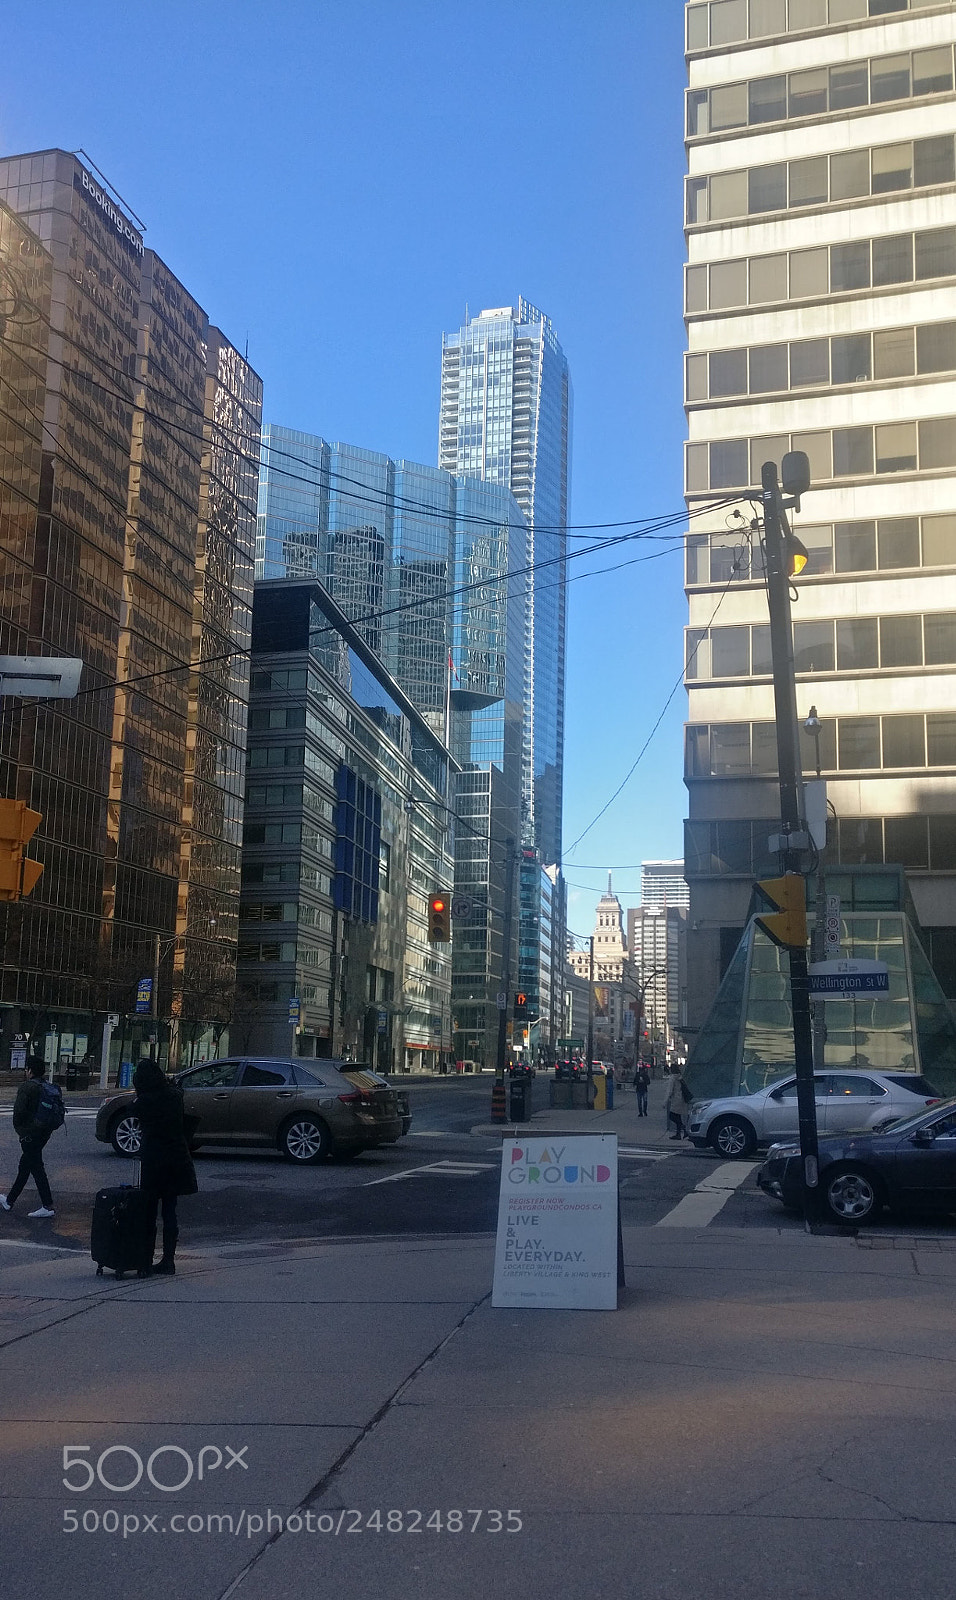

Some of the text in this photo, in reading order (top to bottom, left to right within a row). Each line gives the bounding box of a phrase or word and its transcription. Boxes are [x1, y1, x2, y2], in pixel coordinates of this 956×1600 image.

[82, 170, 145, 257] Booking.com
[811, 975, 886, 990] Wellington St W
[511, 1147, 566, 1165] PLAY
[508, 1165, 611, 1185] GROUND
[507, 1215, 540, 1226] LIVE
[506, 1227, 516, 1238] &
[505, 1239, 545, 1250] PLAY.
[504, 1251, 586, 1262] EVERYDAY.
